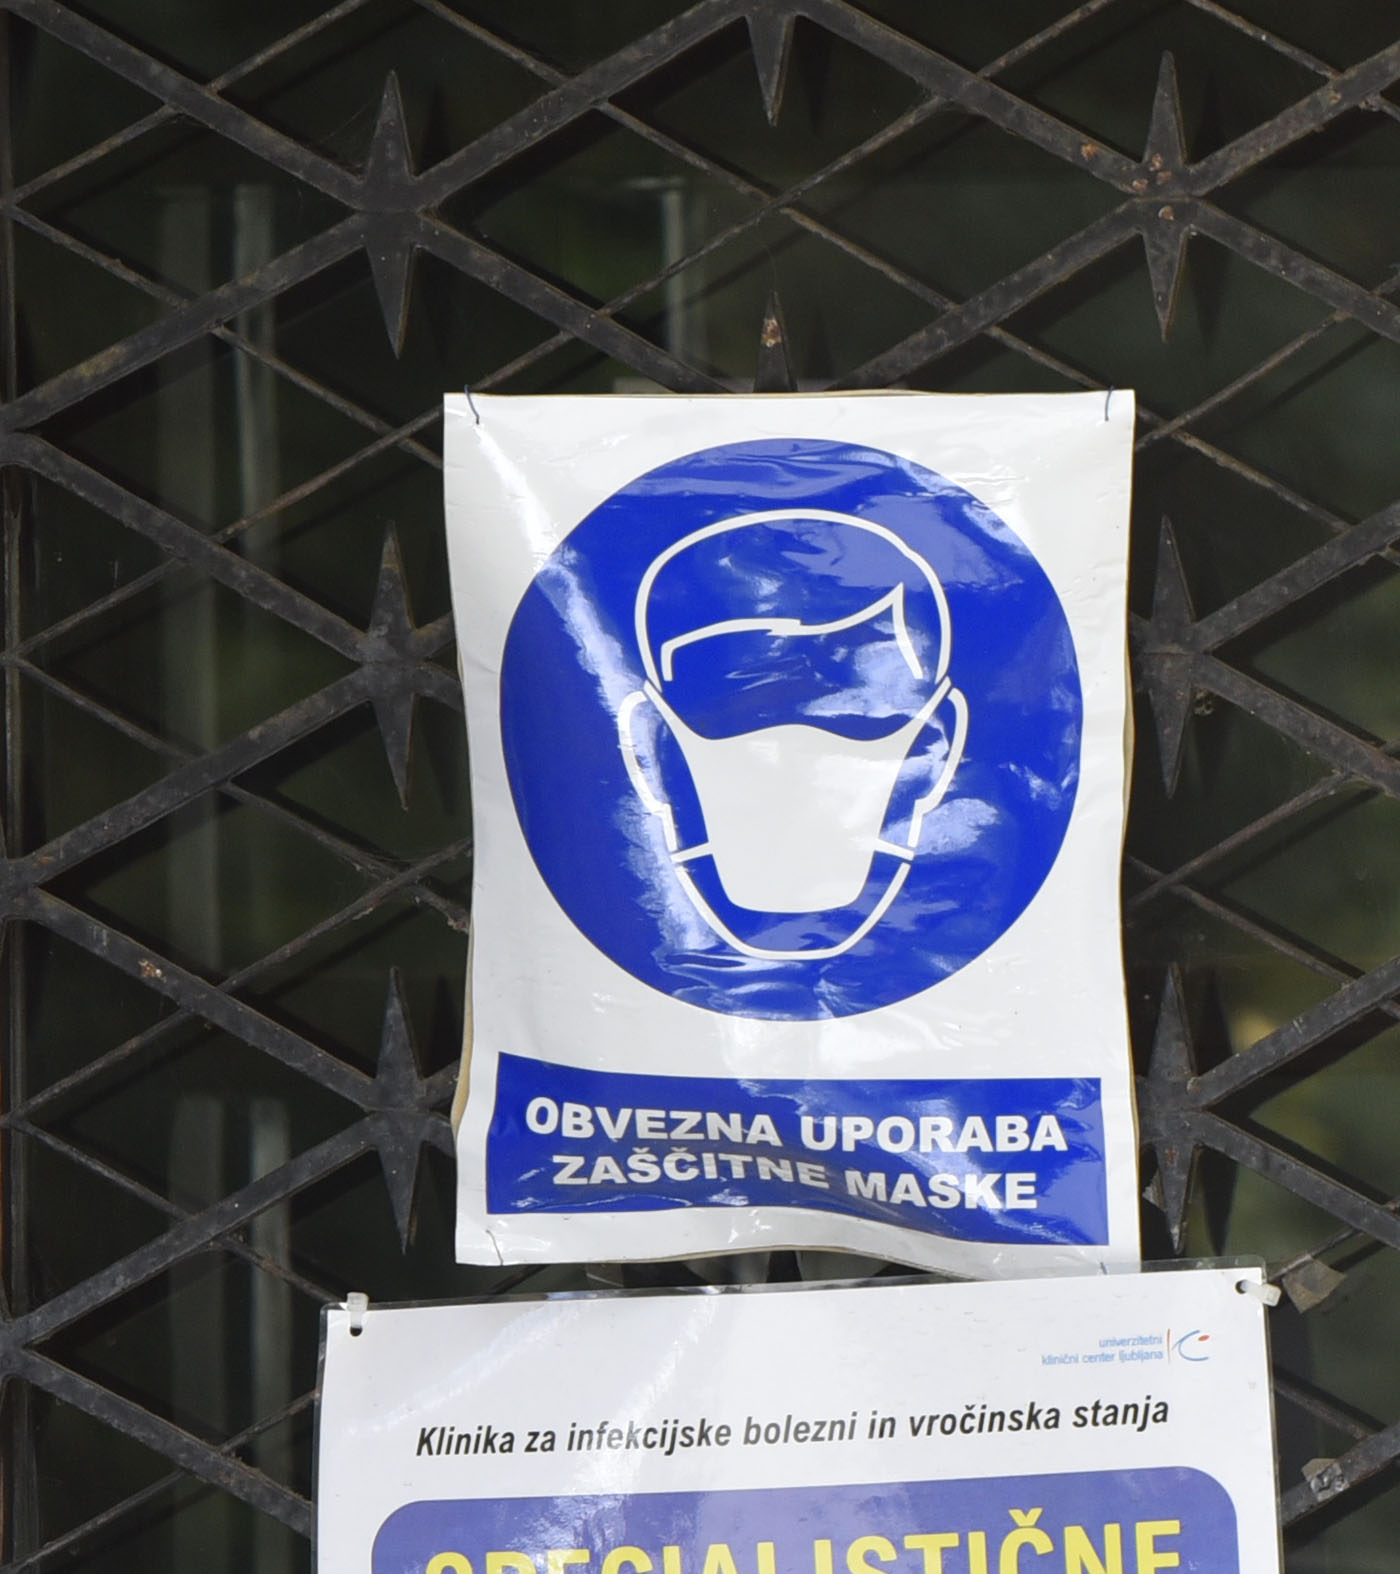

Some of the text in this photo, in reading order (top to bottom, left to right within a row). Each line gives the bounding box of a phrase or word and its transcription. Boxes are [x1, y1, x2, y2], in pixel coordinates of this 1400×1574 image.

[525, 1096, 1068, 1152] OBVEZNA UPORABA
[553, 1144, 1038, 1210] ZAŠČITNE MASKE
[1082, 1352, 1115, 1362] center
[1119, 1350, 1163, 1363] ljubljana
[1099, 1335, 1162, 1348] univerzitetni
[416, 1395, 1169, 1456] Klinika za infekcijske bolezni in vročinska stanja
